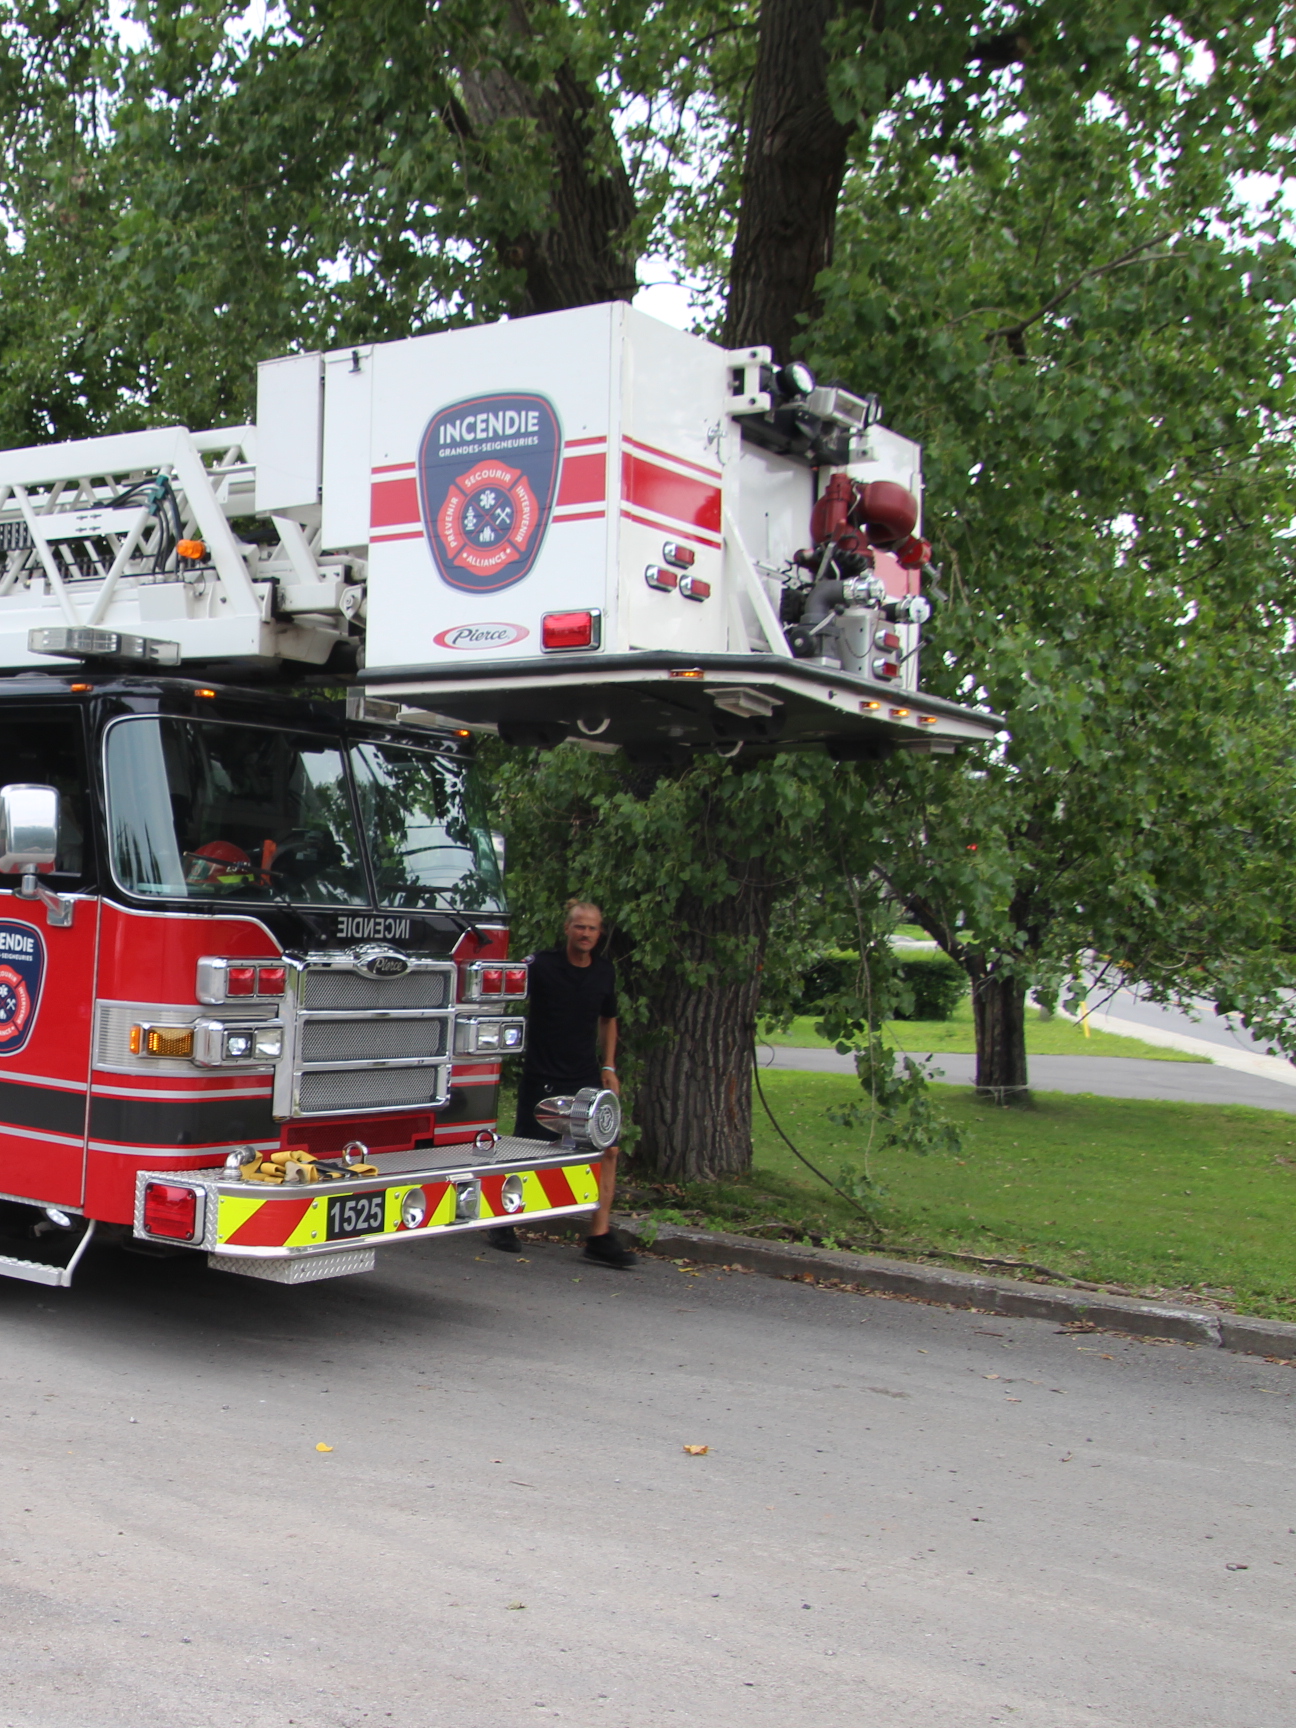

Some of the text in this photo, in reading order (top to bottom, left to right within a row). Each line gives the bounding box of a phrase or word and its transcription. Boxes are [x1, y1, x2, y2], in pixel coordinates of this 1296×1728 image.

[439, 411, 540, 445] INCENDIE
[438, 436, 539, 457] GRANDES-SEIGNEURIES
[465, 469, 511, 488] SECOURIR
[445, 496, 459, 548] PRÉVENIR
[516, 486, 531, 543] INTERVENIR
[467, 551, 506, 567] ALLIANCE
[452, 628, 508, 645] Pierce
[372, 958, 404, 973] Pierce
[329, 1197, 383, 1233] 1525
